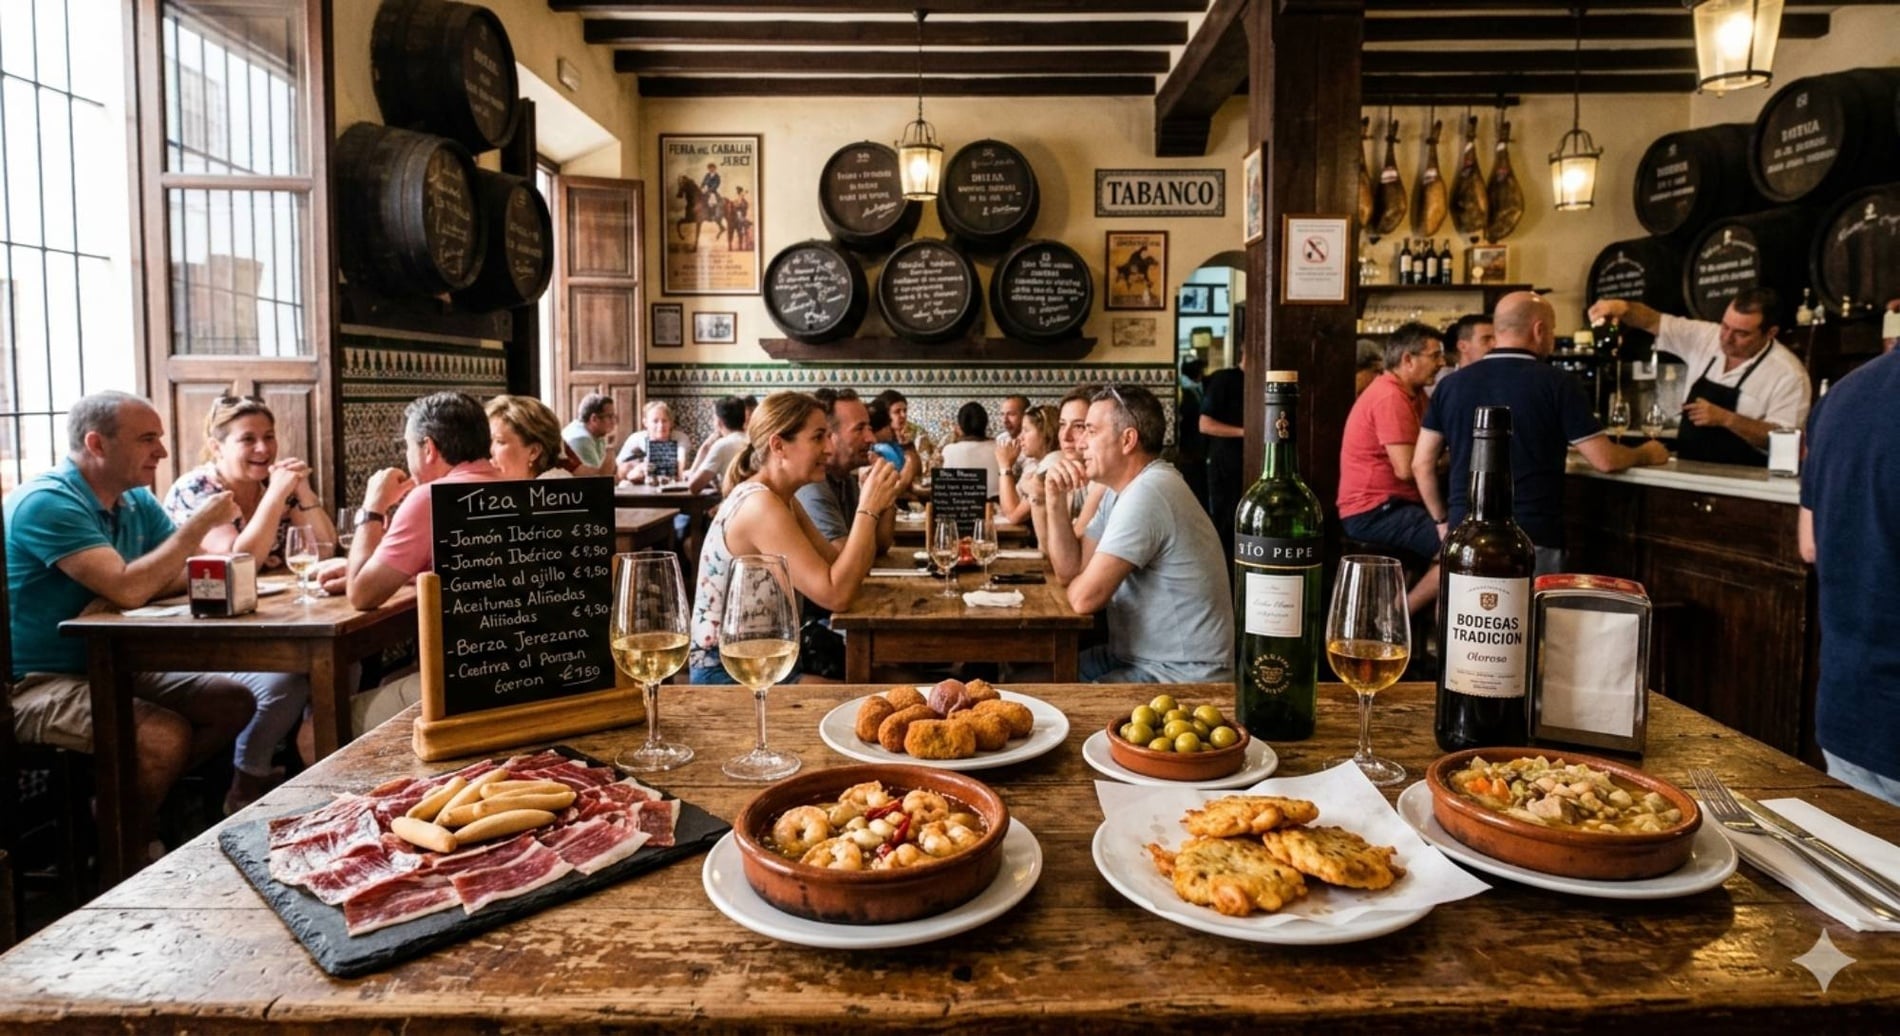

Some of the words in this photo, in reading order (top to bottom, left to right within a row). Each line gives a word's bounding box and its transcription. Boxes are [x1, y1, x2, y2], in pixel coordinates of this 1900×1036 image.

[1107, 181, 1214, 206] TABANCO
[529, 485, 583, 507] Menu
[1273, 547, 1313, 558] PEPE
[512, 569, 525, 586] al
[1457, 613, 1519, 631] BODEGAS
[513, 628, 590, 652] Jerezana
[1452, 627, 1522, 645] TRADICION
